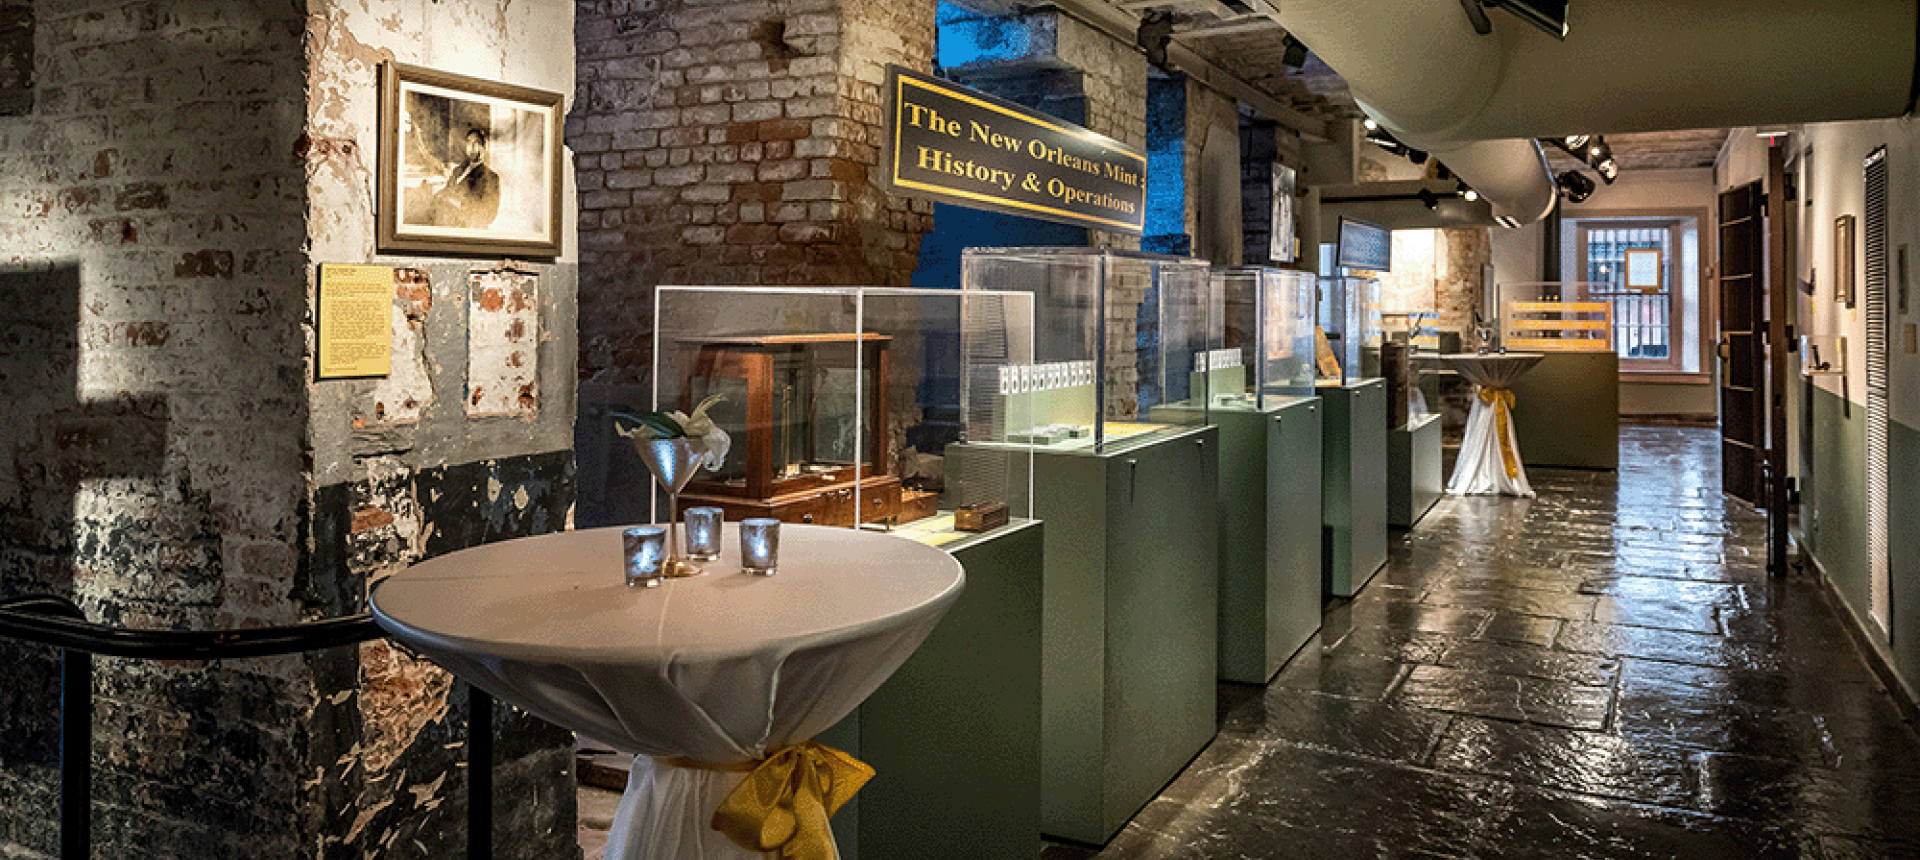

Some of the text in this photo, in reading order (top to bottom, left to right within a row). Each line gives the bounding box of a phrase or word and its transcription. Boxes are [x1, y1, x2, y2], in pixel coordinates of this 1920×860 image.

[904, 103, 961, 136] The
[969, 120, 1022, 152] New
[1028, 139, 1100, 175] Orleans
[917, 145, 1135, 214] History & Operations
